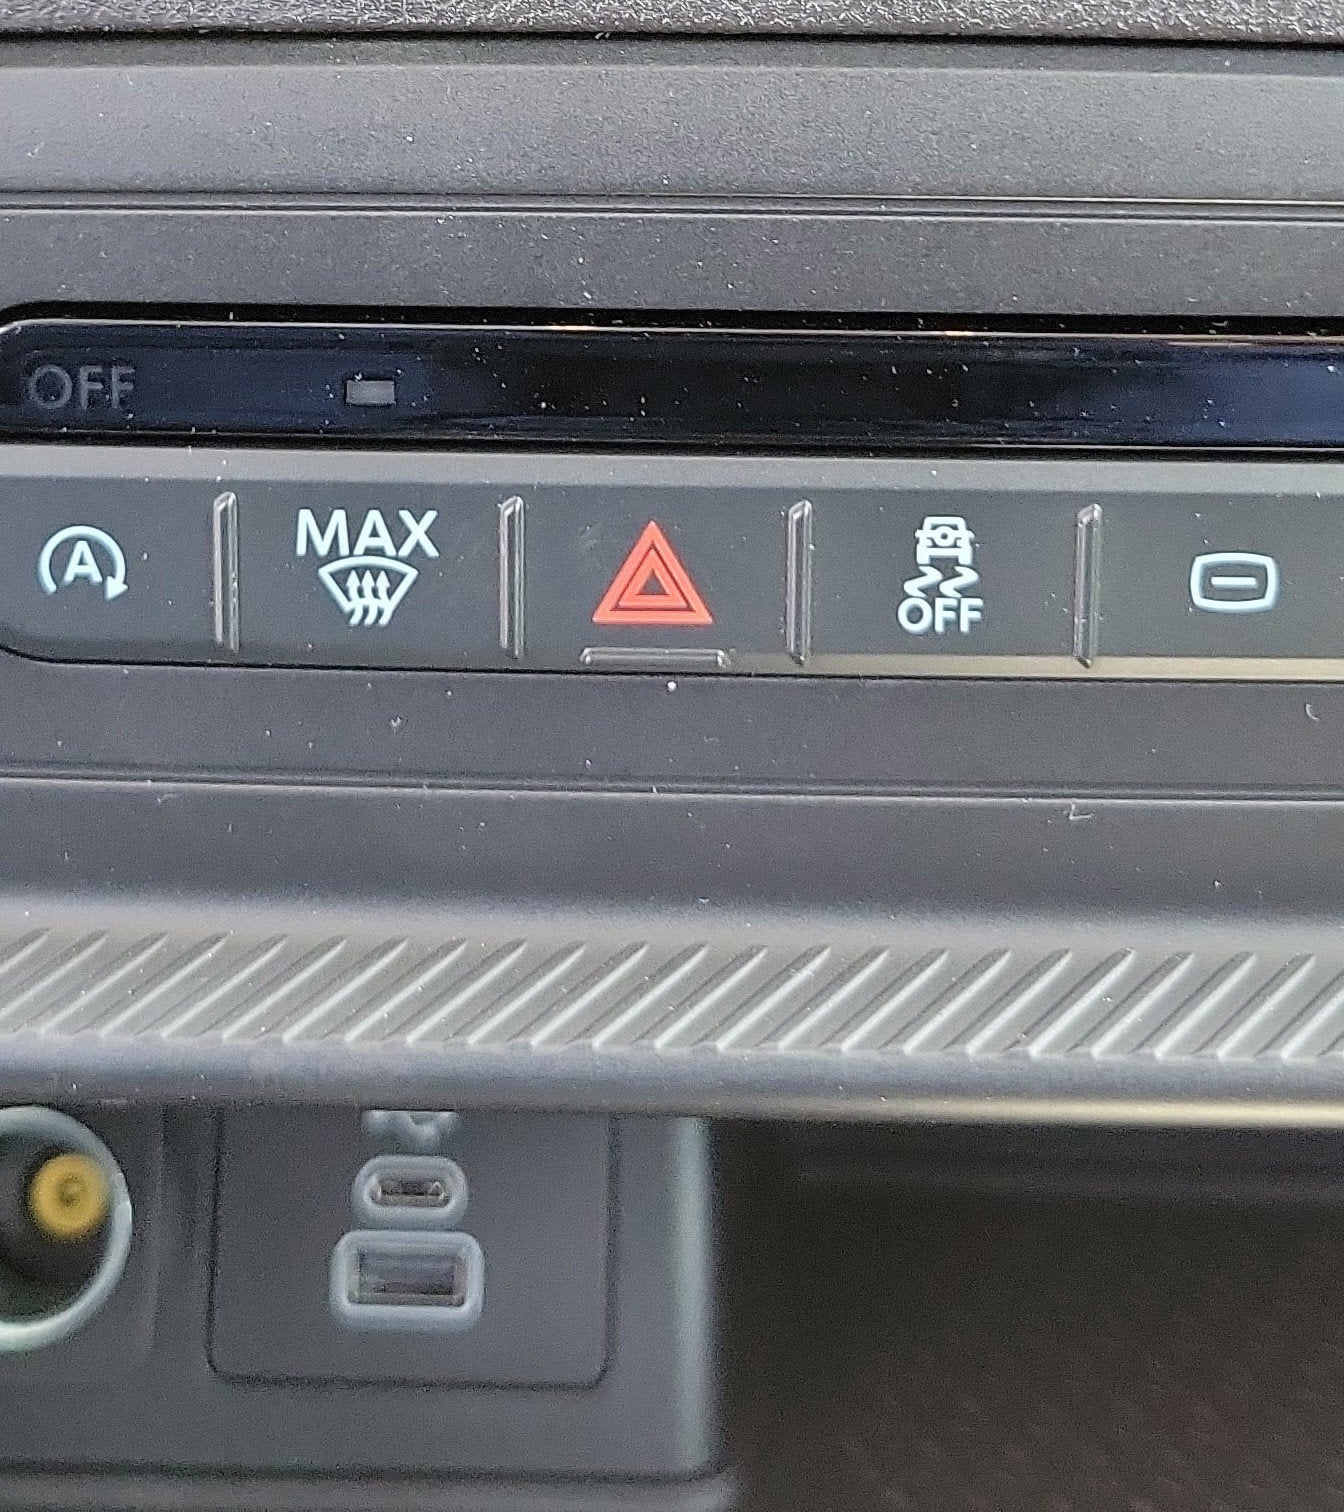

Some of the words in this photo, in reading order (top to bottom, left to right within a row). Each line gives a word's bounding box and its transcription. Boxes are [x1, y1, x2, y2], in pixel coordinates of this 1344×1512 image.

[28, 364, 136, 411] OFF
[296, 508, 439, 558] MAX
[61, 540, 104, 587] A
[897, 597, 984, 635] OFF
